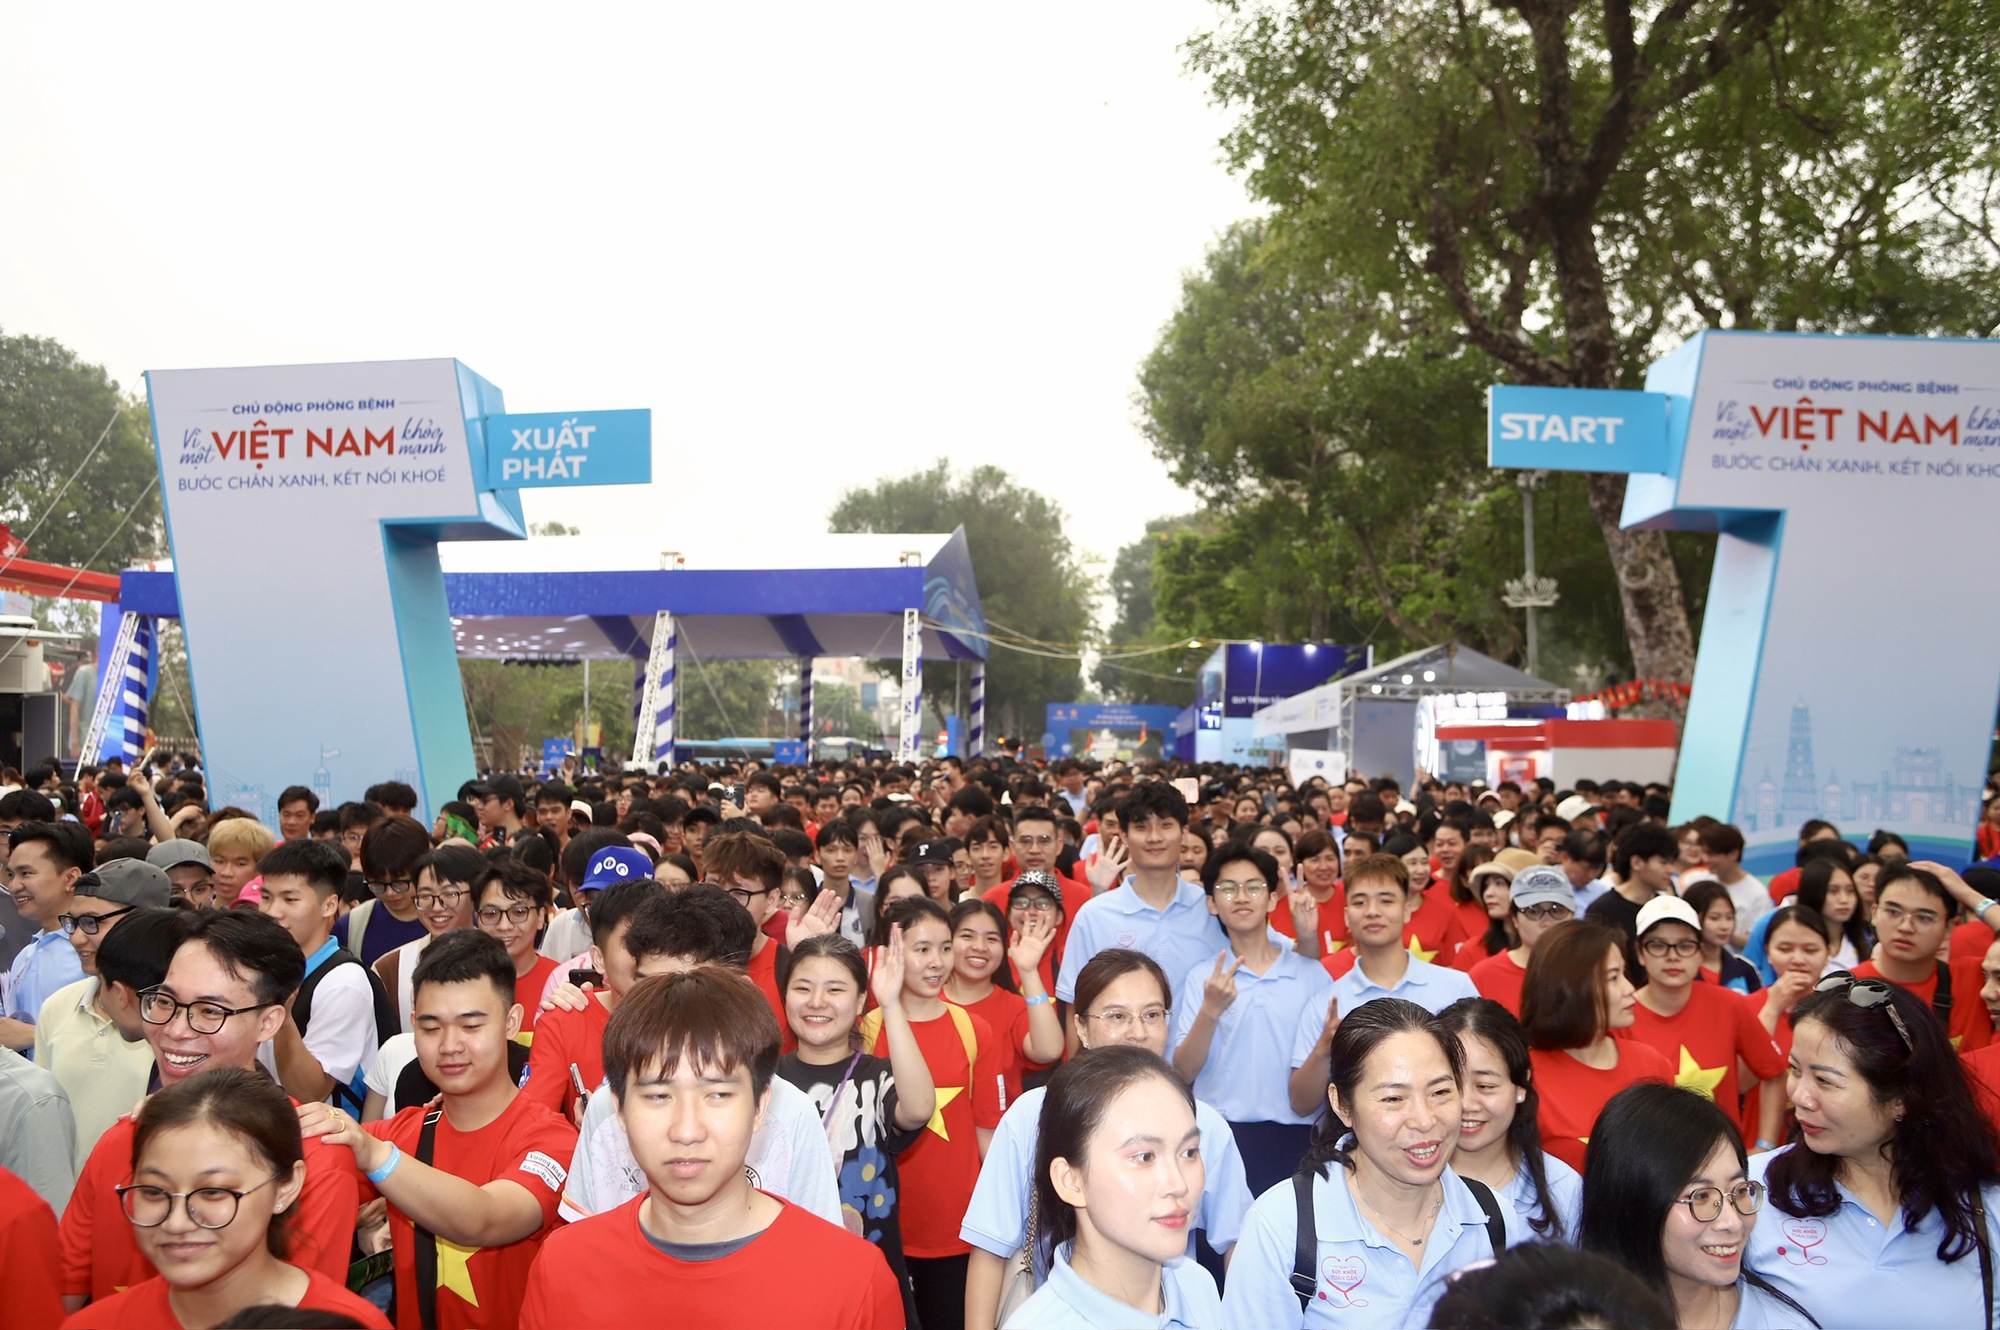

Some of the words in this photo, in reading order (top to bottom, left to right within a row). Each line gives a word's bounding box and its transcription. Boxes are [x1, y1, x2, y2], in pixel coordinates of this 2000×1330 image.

[1808, 377, 1854, 392] ĐỘNG
[1857, 379, 1912, 394] PHÒNG
[1916, 381, 1960, 395] BỆNH
[232, 401, 260, 415] CHỦ
[264, 401, 303, 415] ĐỘNG
[307, 399, 354, 412] PHÒNG
[358, 396, 395, 412] BỆNH
[511, 417, 597, 451] XUẤT
[1500, 413, 1624, 444] START
[1749, 396, 1844, 452] VIỆT
[1857, 409, 1959, 446] NAM
[183, 427, 202, 449] Vì
[211, 419, 294, 470] VIỆT
[306, 425, 395, 458] NAM
[398, 434, 447, 461] mạnh
[179, 443, 217, 470] một
[502, 449, 588, 481] PHÁT
[1711, 452, 1763, 471] BƯỚC
[1768, 454, 1822, 473] CHÂN
[1888, 456, 1921, 476] KẾT
[1926, 458, 1962, 477] NỐI
[178, 474, 223, 492] BƯỚC
[227, 472, 274, 490] CHÂN
[333, 468, 362, 486] KẾT
[366, 466, 396, 484] NỐI
[918, 844, 929, 856] F
